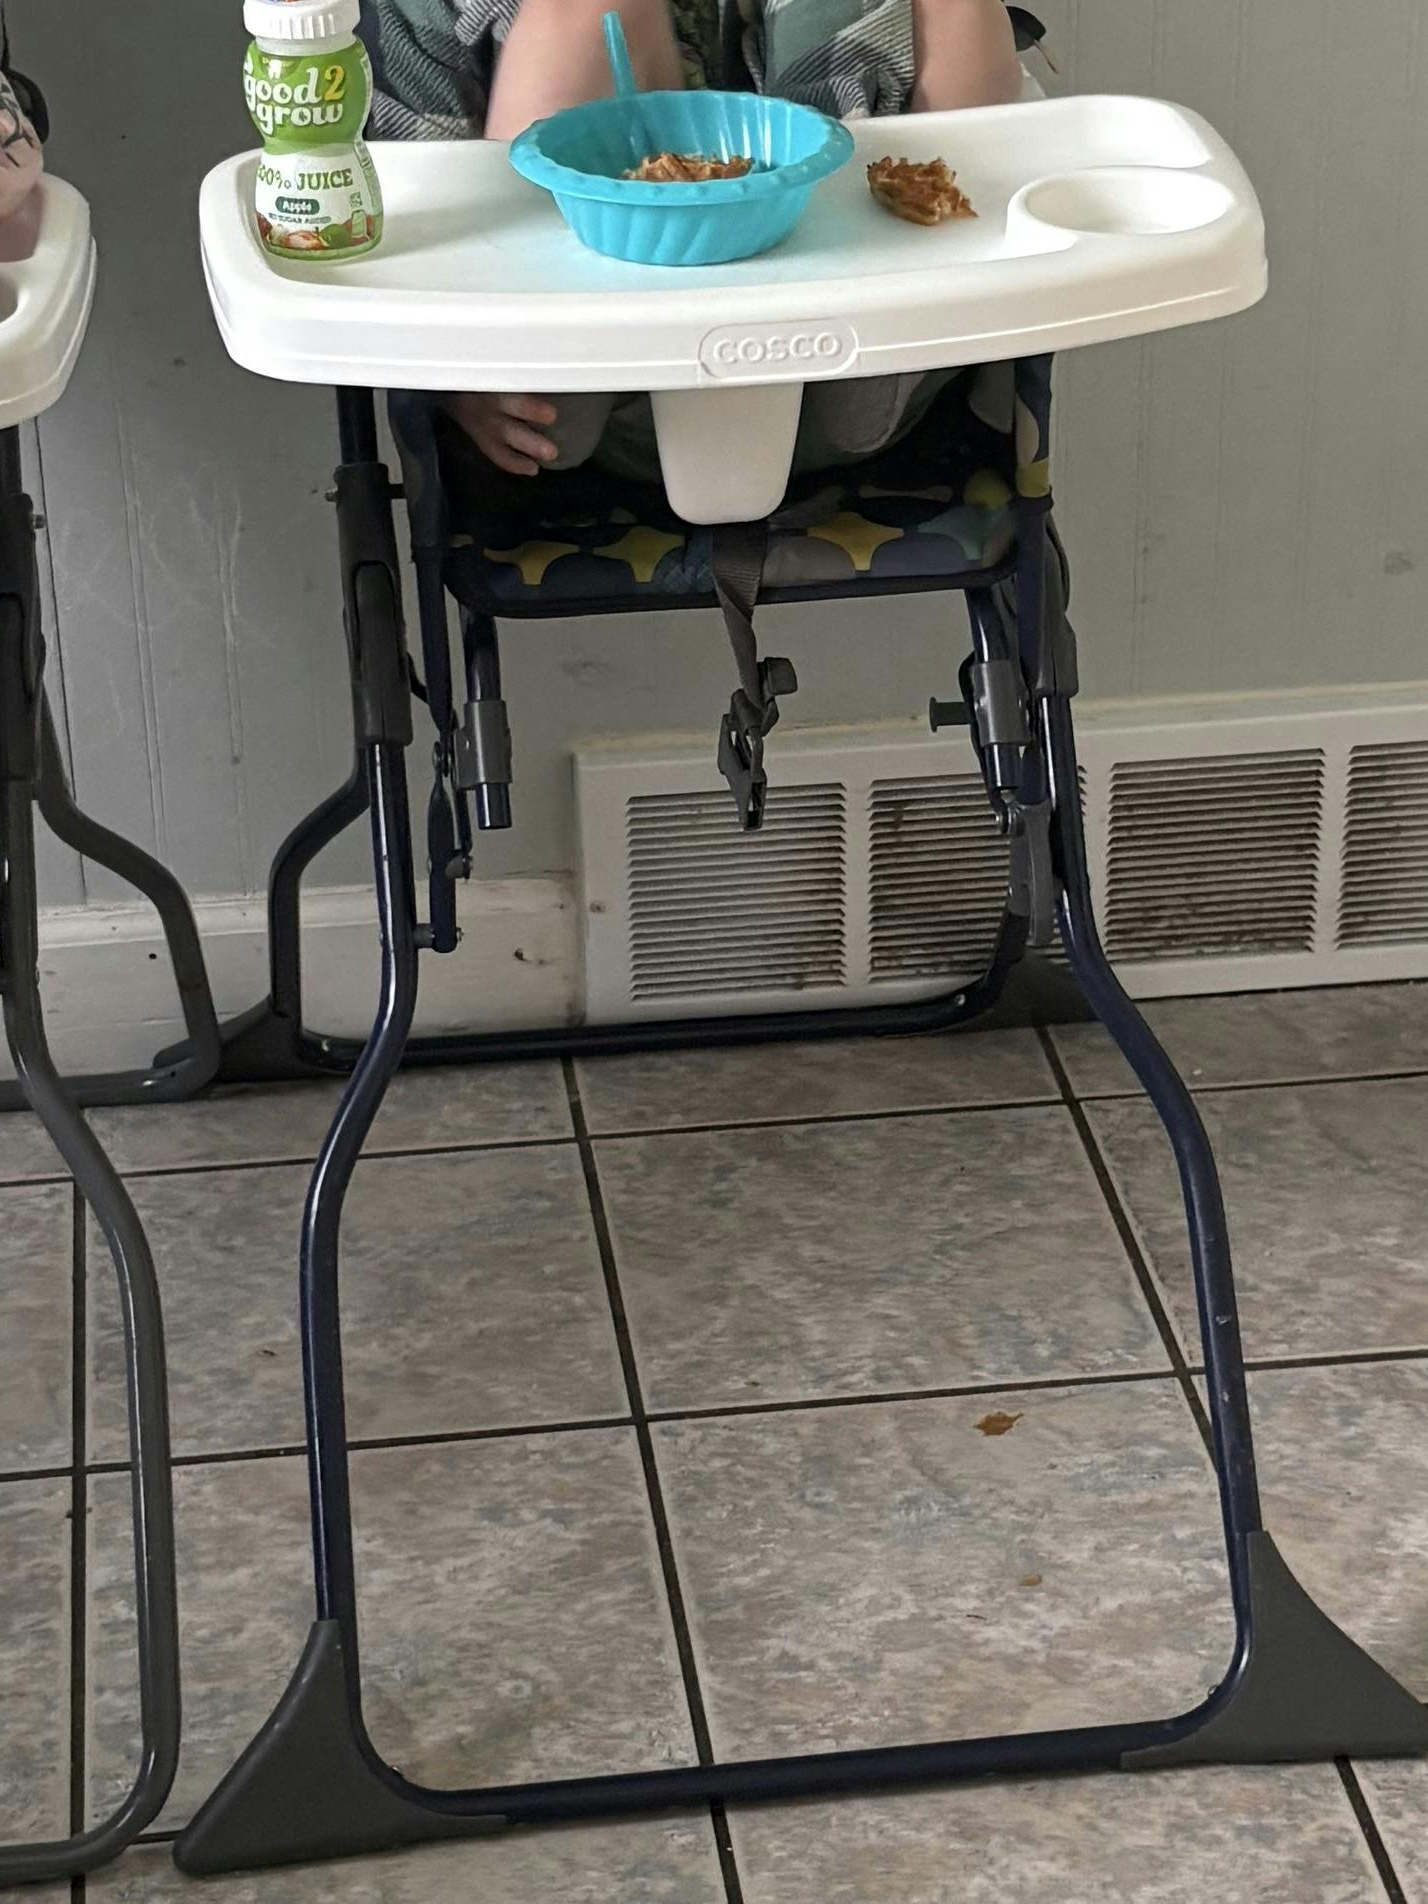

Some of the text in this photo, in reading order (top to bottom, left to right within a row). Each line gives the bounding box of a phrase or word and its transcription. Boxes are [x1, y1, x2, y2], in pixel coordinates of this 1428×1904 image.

[256, 103, 344, 135] grow
[296, 168, 353, 191] JUICE
[713, 332, 842, 364] COSCO
